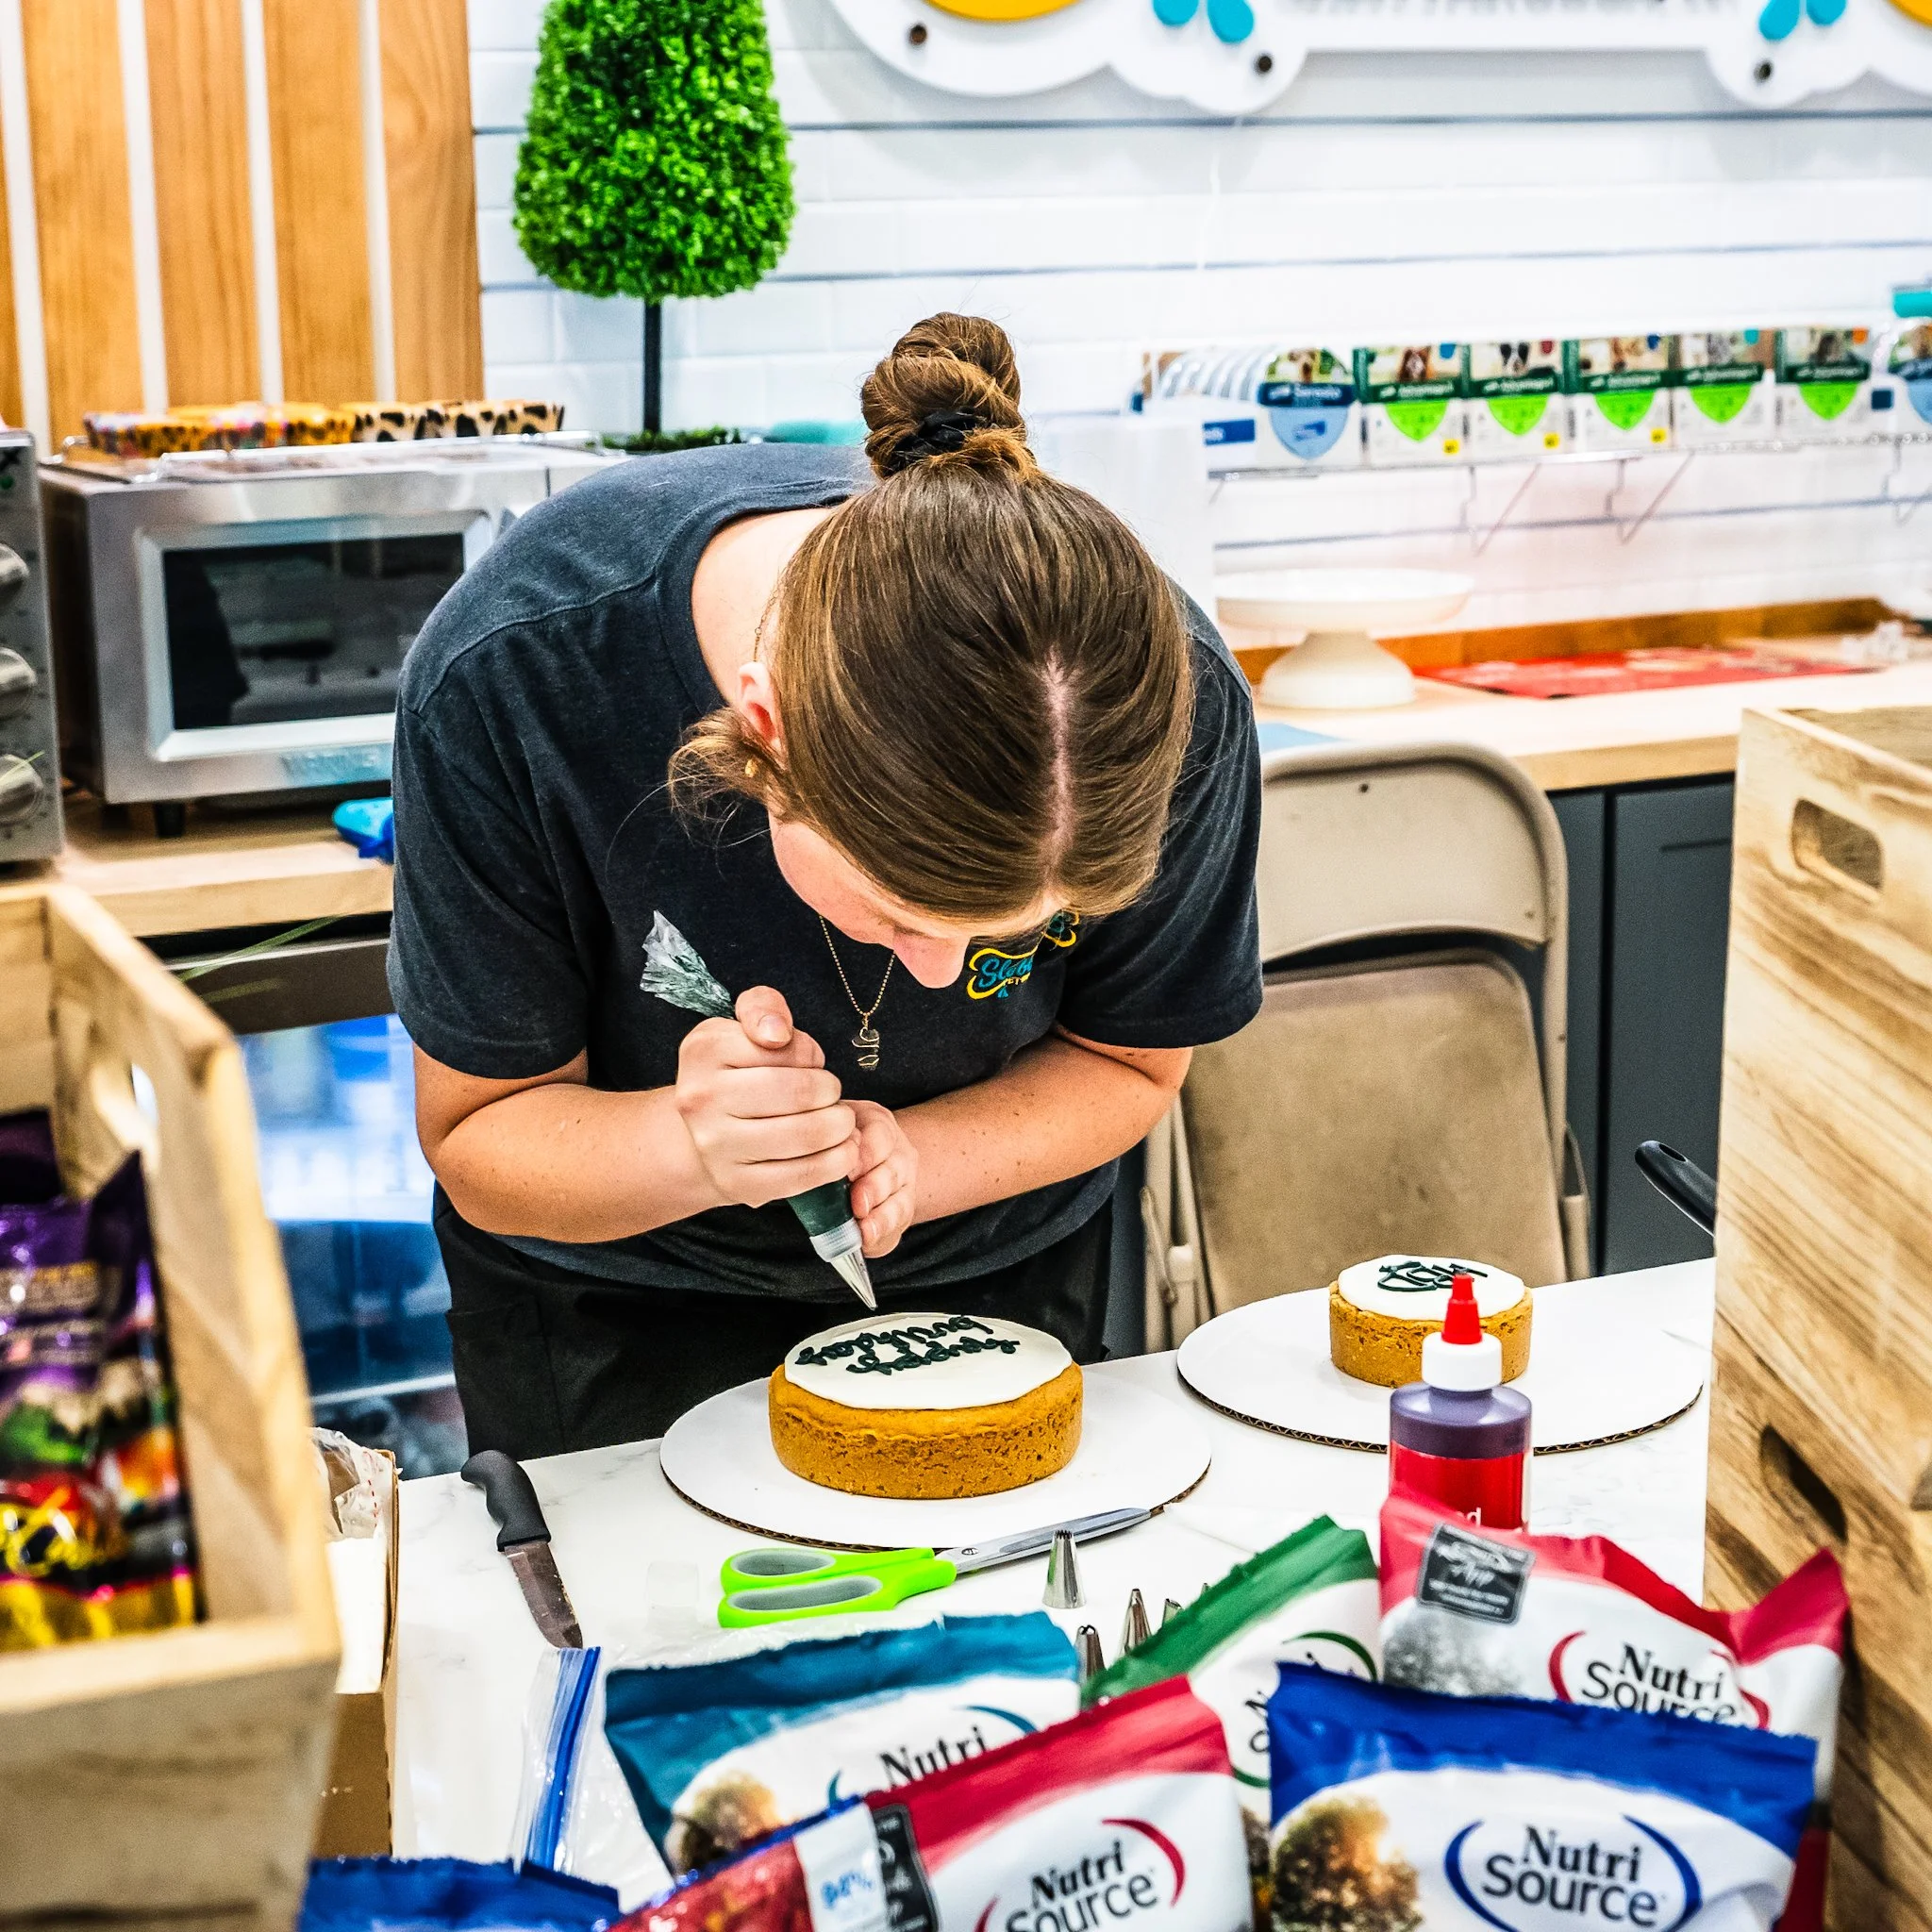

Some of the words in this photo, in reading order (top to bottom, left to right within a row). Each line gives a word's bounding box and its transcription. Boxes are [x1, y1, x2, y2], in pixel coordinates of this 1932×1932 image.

[1620, 1641, 1724, 1700] Nutri
[880, 1724, 987, 1788] Nutri
[1030, 1840, 1124, 1909] Nutri
[1523, 1824, 1641, 1882] Nutri
[1482, 1854, 1657, 1928] Source
